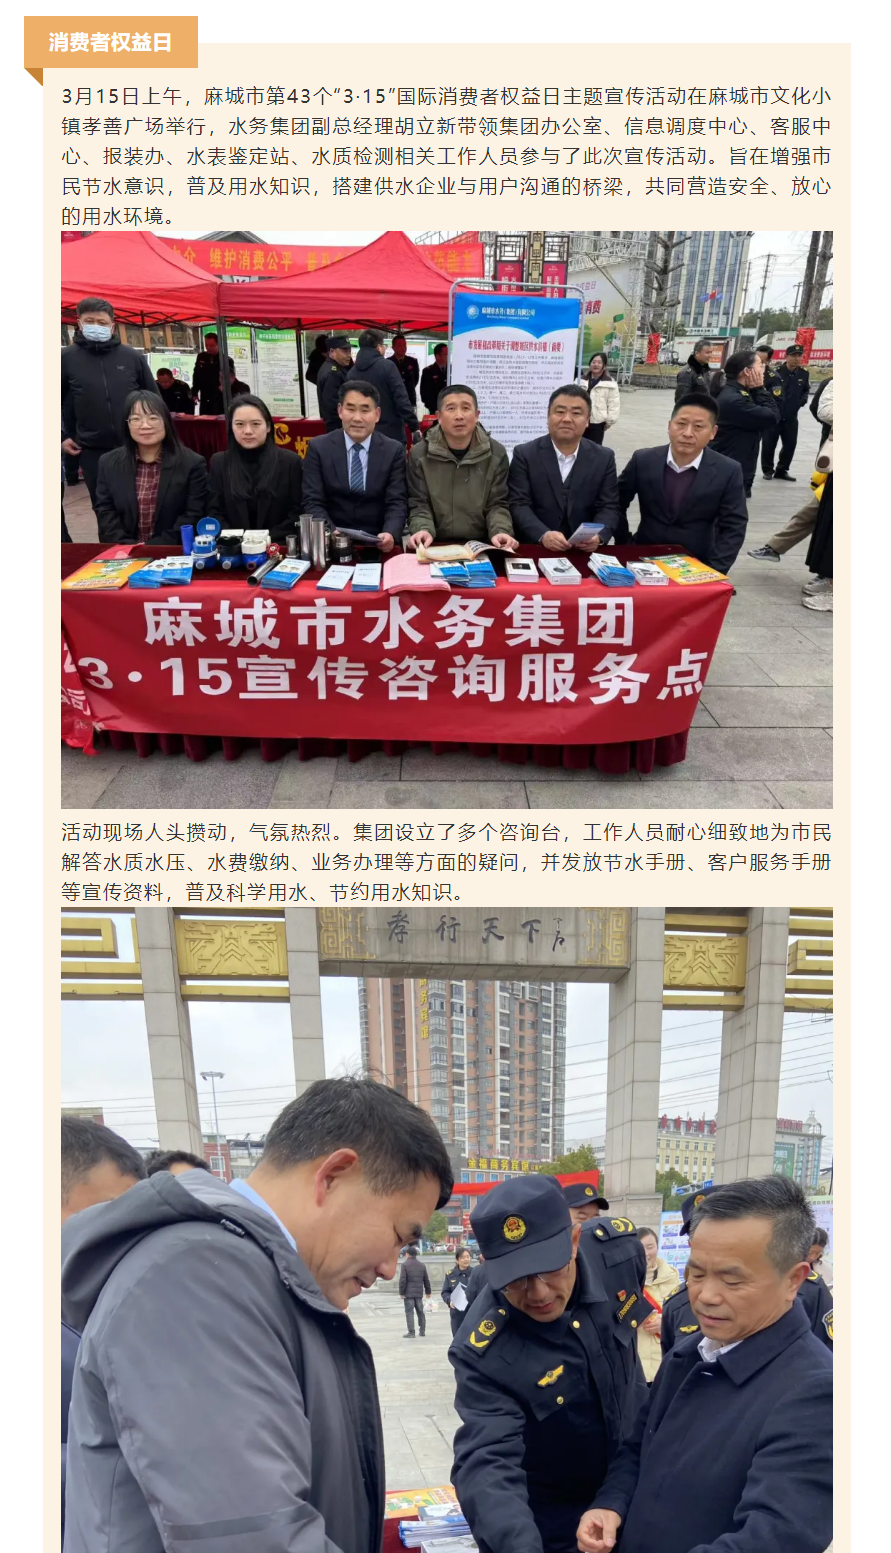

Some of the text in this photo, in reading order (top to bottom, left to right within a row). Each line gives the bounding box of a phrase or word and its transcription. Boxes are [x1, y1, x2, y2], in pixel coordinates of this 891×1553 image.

[209, 247, 294, 272] 维护消费公平
[143, 594, 634, 652] 麻城市水务集团
[78, 648, 709, 704] 3·15宣传咨询服务点
[387, 910, 542, 945] 孝行天下
[467, 1157, 530, 1172] 金福商务宾馆
